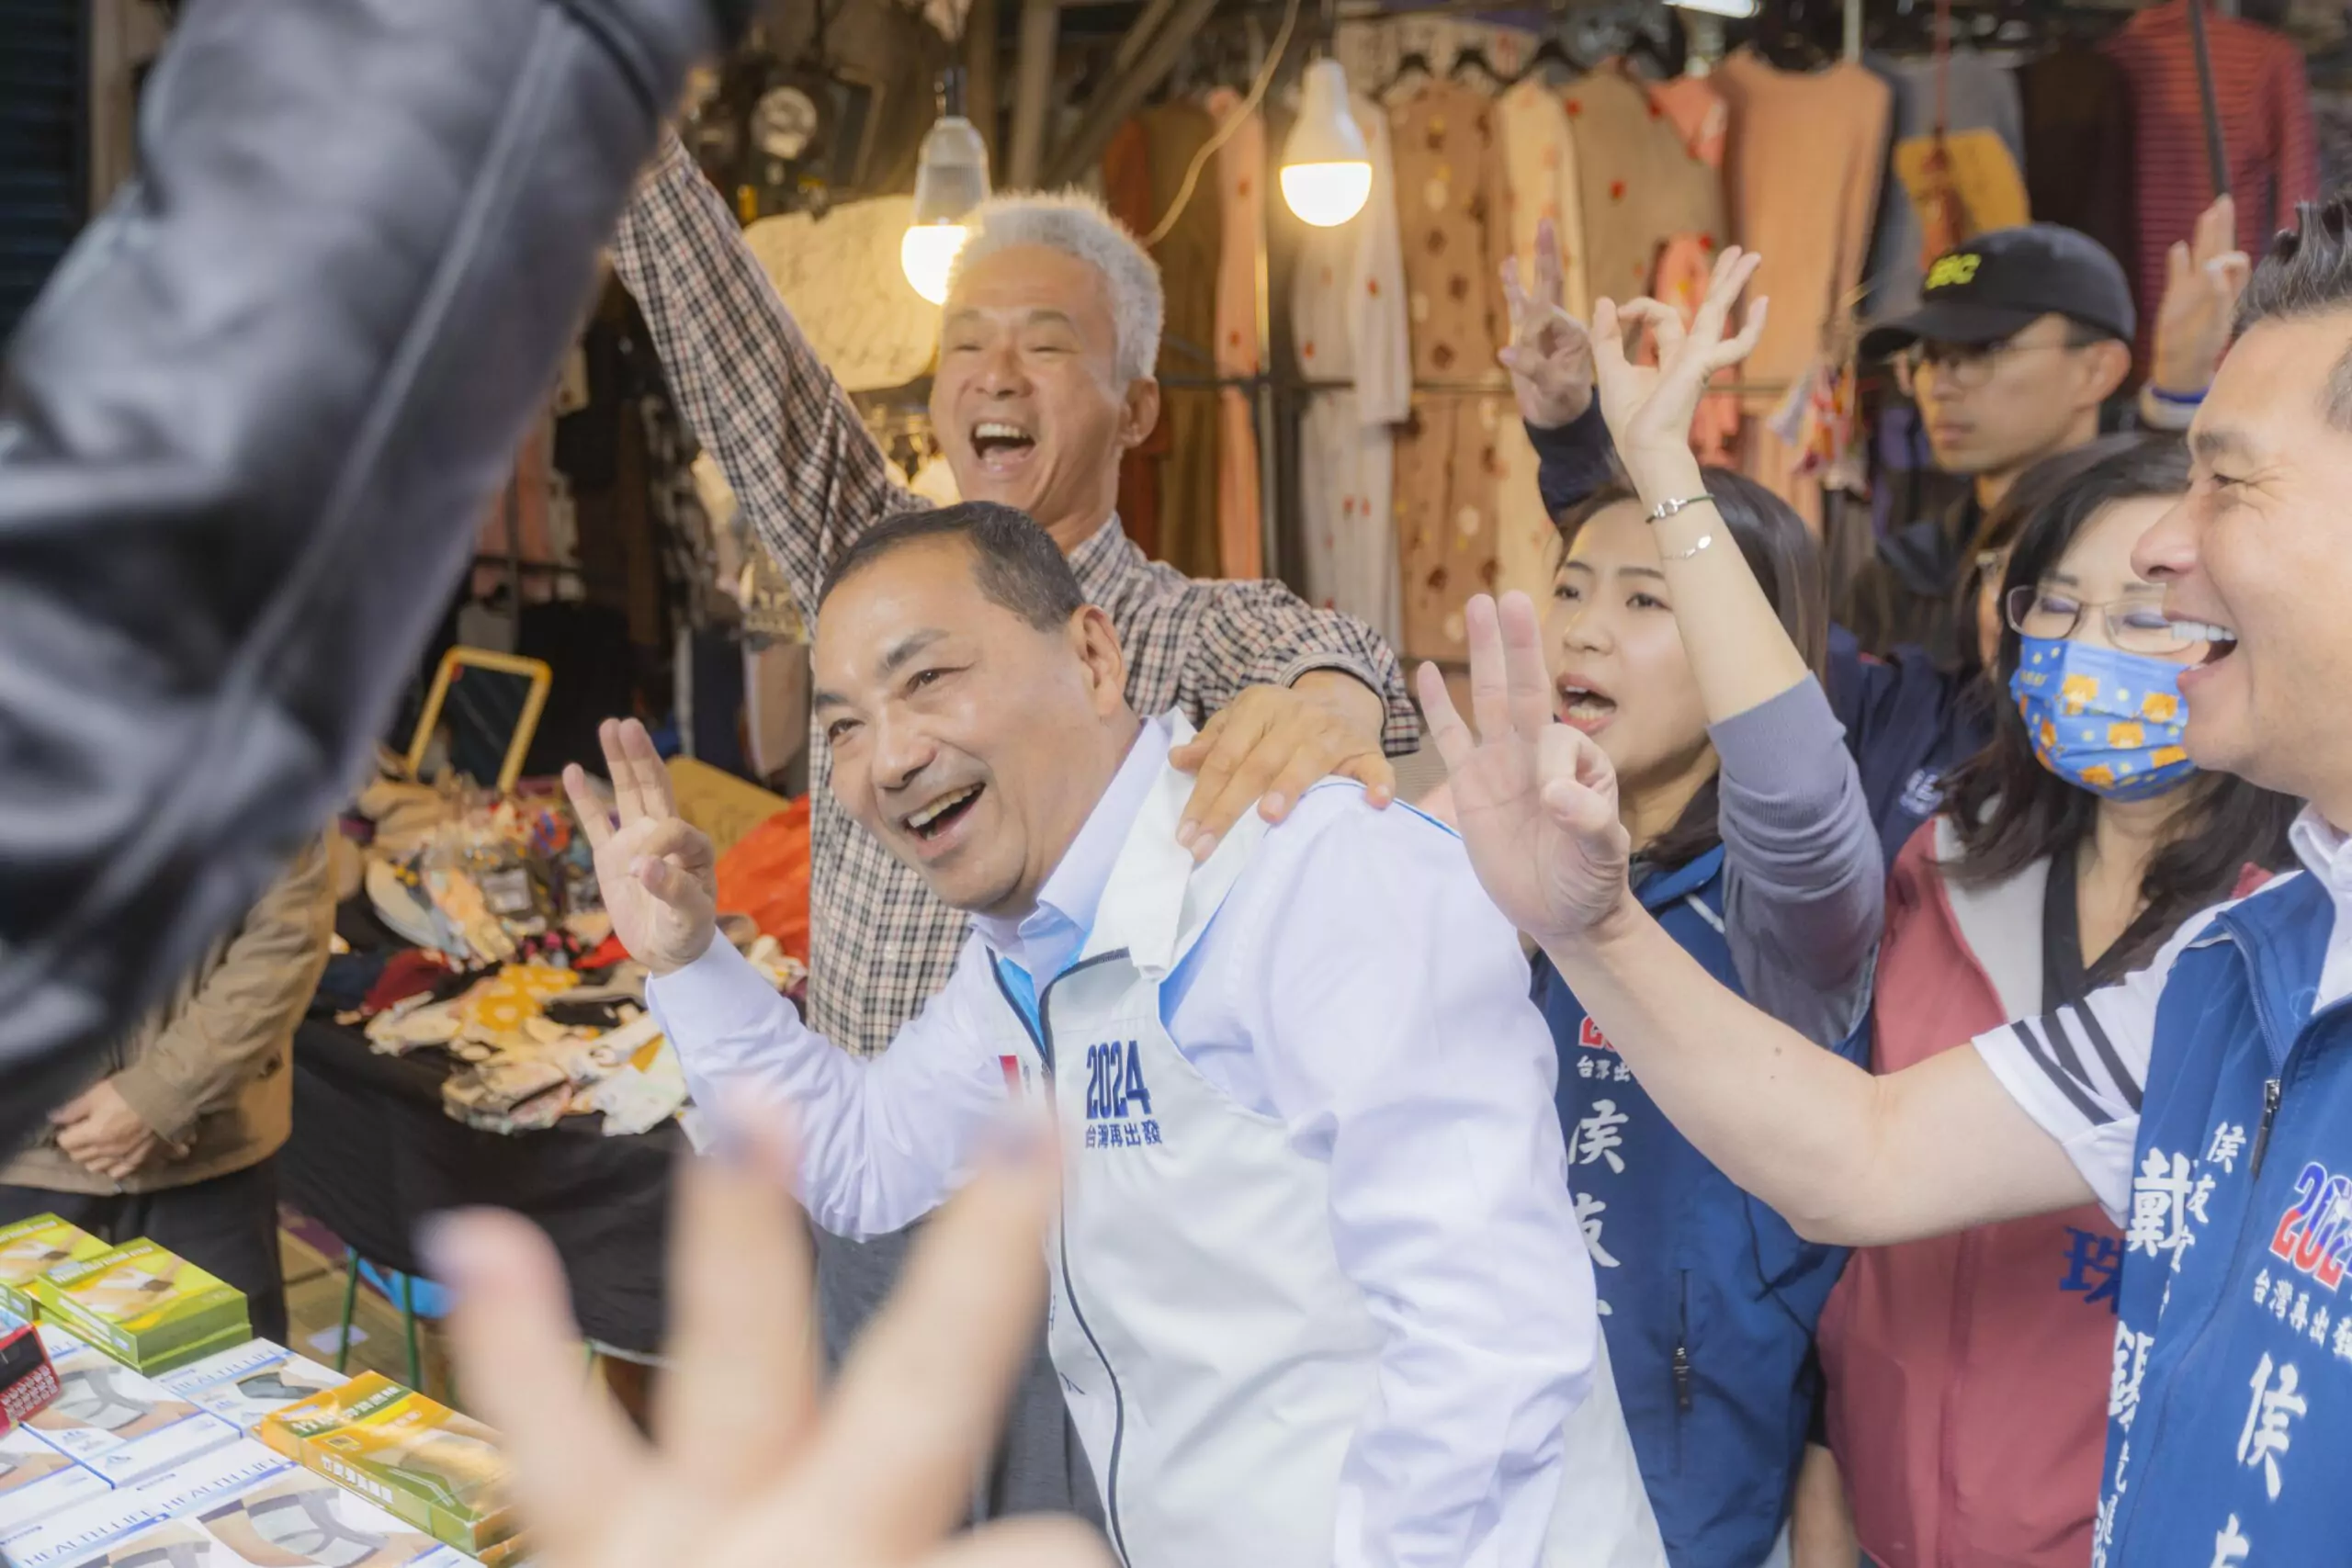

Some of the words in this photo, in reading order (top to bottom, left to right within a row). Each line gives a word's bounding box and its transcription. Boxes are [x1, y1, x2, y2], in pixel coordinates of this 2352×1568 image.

[1086, 1039, 1153, 1120] 2024
[1085, 1119, 1163, 1149] 台灣再出發
[1567, 1099, 1630, 1316] 侯友
[2268, 1161, 2352, 1292] 202
